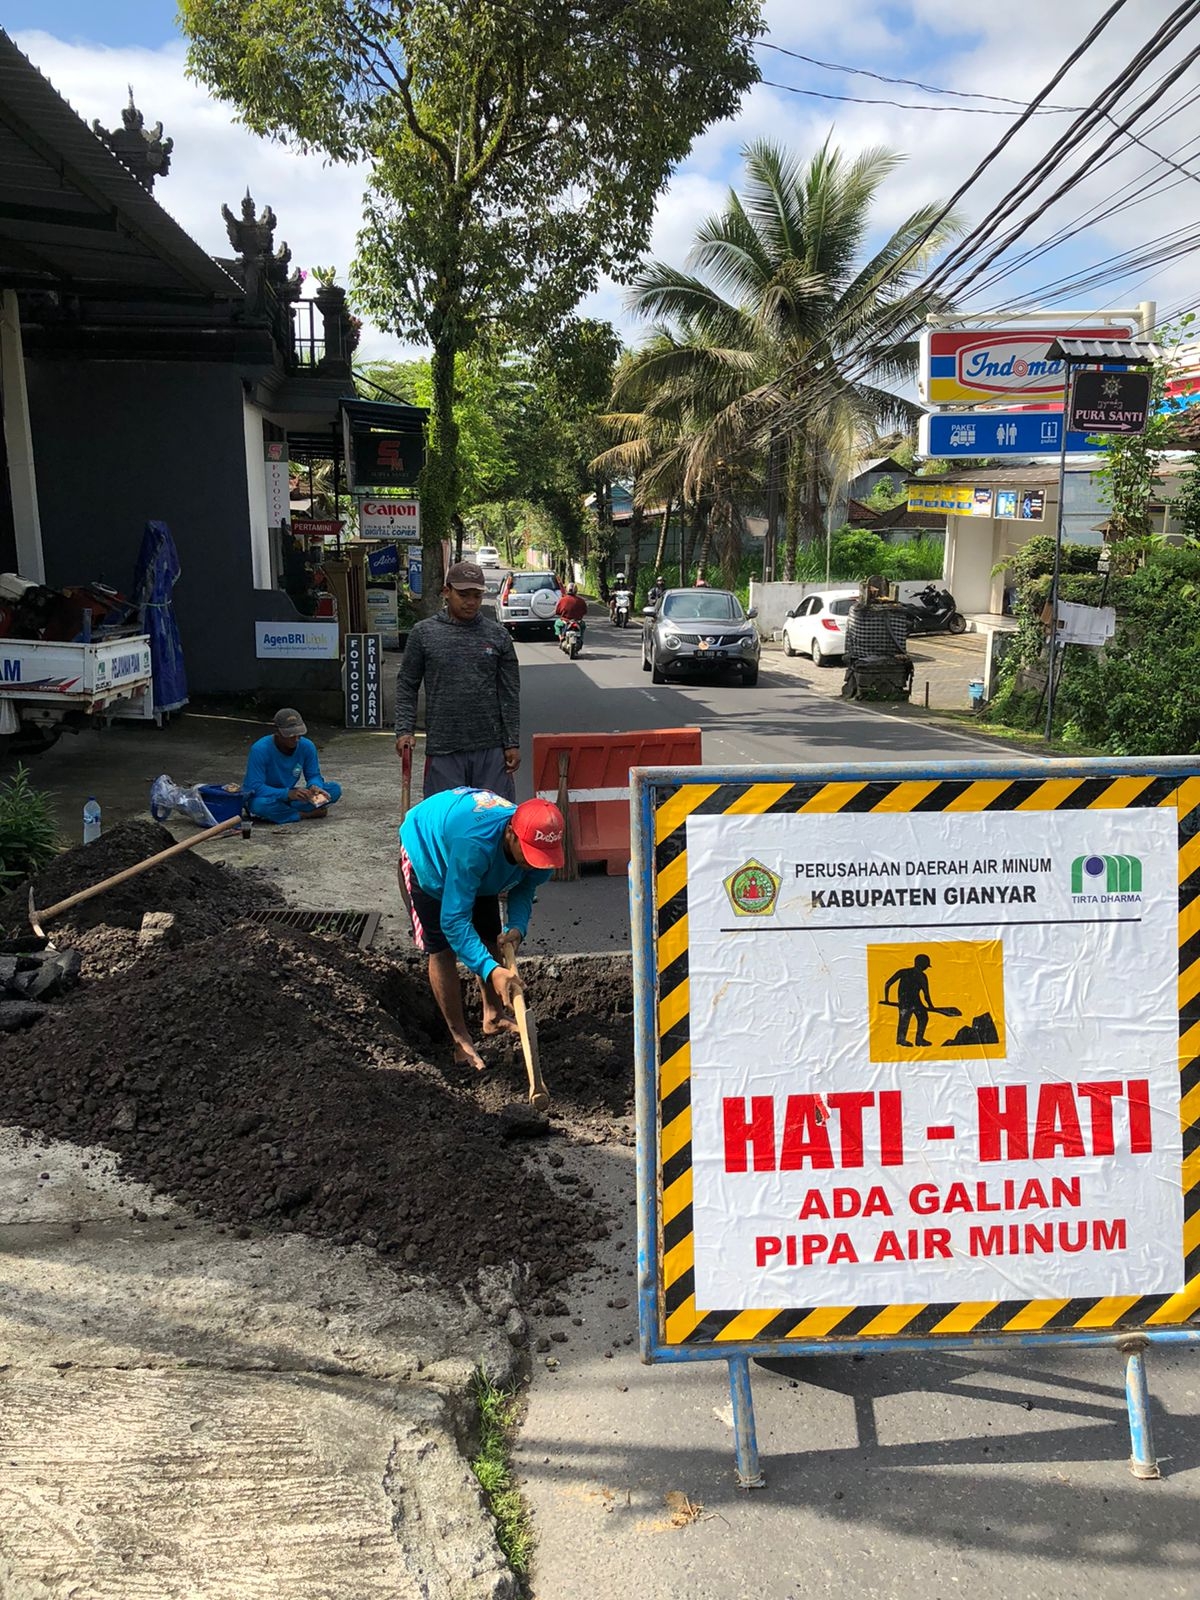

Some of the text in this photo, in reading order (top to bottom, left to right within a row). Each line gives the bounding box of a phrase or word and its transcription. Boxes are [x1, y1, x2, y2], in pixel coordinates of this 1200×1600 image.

[1075, 410, 1143, 422] PURA SANTI
[364, 503, 416, 516] Canon
[294, 523, 332, 532] PERTAMINI
[373, 555, 396, 567] Aice
[350, 639, 359, 723] FOTOCOPY
[367, 639, 377, 725] PRINT WARNA
[795, 858, 1052, 878] PERUSAHAAN DAERAH AIR MINUM
[811, 885, 1037, 908] KABUPATEN GIANYAR
[1072, 894, 1142, 904] TIRTA DHARMA
[722, 1090, 903, 1172] HATI
[977, 1079, 1152, 1162] HATI
[798, 1176, 1081, 1220] ADA GALIAN
[755, 1219, 1127, 1267] PIPA AIR MINUM
